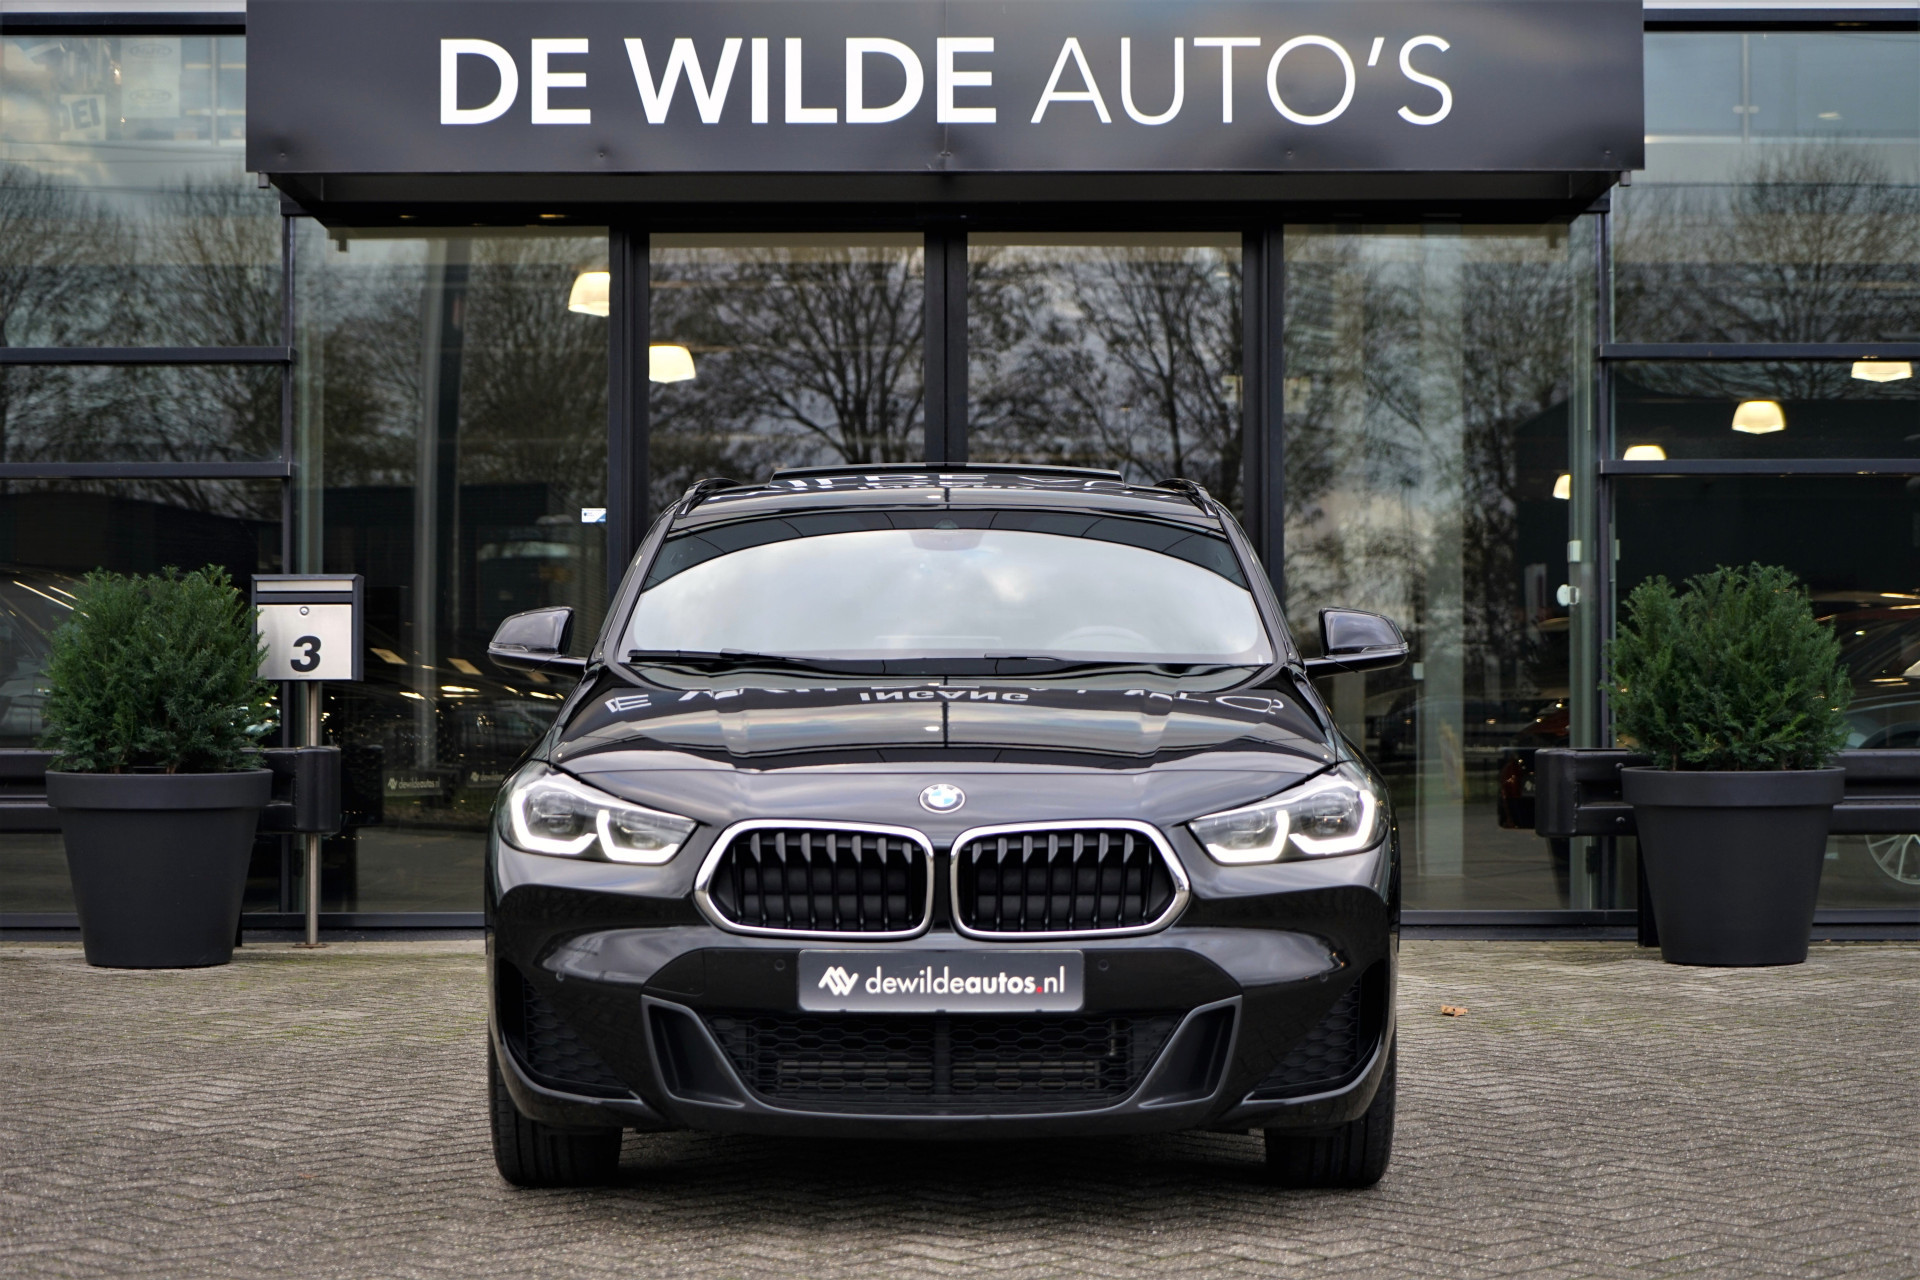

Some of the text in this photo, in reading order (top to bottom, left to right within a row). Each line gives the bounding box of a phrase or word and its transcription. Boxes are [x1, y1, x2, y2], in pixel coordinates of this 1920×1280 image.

[440, 34, 1453, 126] DE WILDE AUTO'S
[290, 635, 322, 673] 3
[865, 965, 1065, 994] dewildeautos.nl
